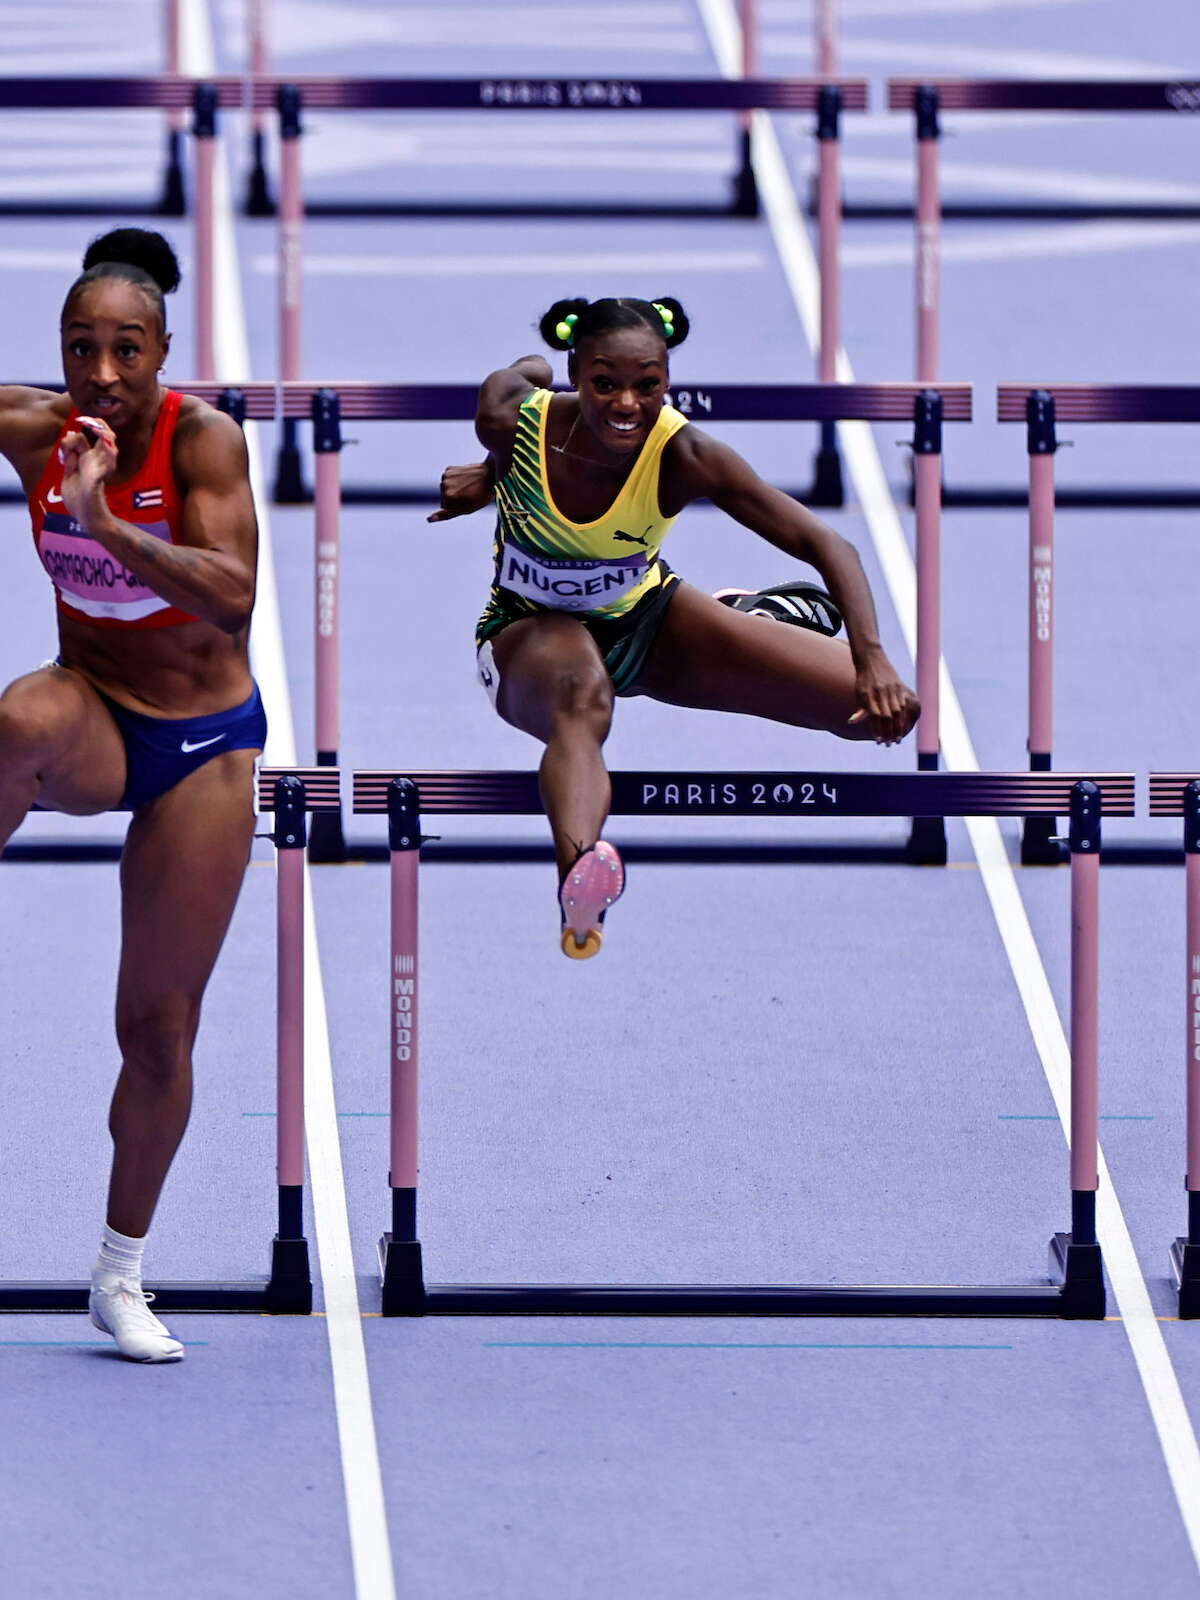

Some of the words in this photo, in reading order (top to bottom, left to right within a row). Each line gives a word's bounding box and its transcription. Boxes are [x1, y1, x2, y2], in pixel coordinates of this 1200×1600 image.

[508, 557, 640, 597] NUGENT
[751, 783, 837, 804] 2024
[394, 979, 414, 1061] MONDO
